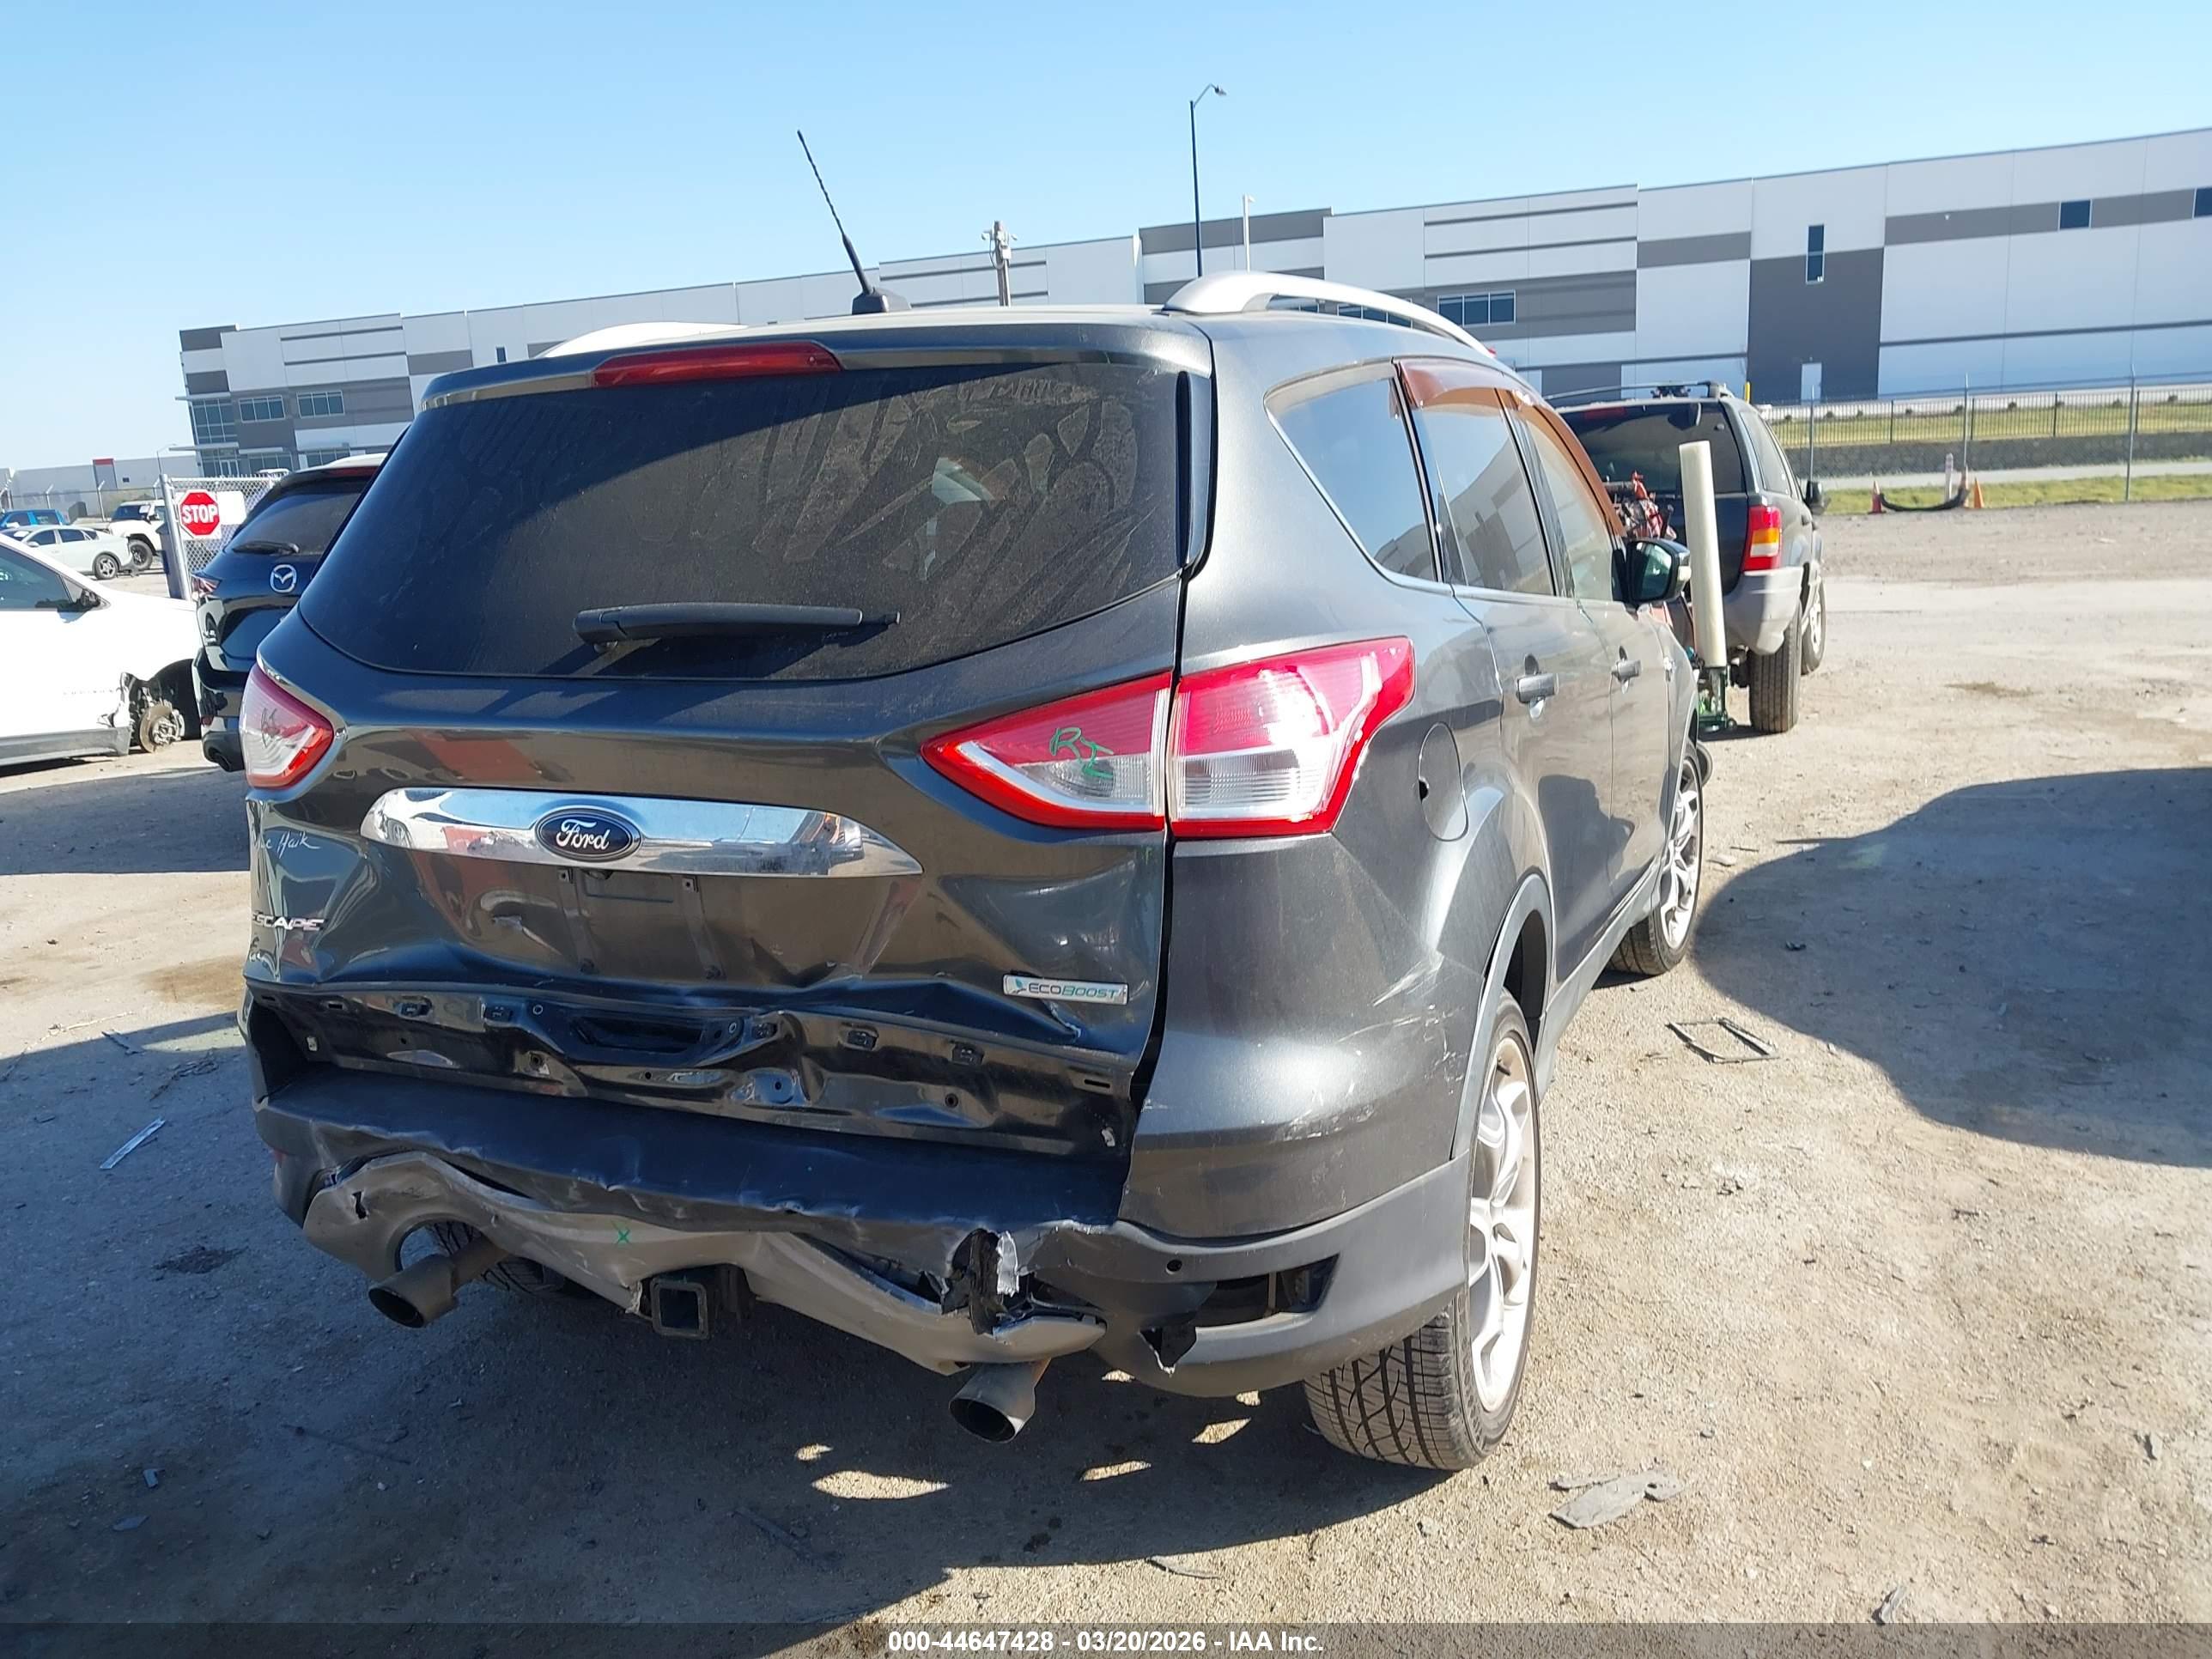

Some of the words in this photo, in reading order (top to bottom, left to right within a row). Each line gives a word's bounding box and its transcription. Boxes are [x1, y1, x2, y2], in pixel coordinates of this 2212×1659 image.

[182, 504, 218, 524] STOP
[276, 830, 321, 859] Haik
[556, 818, 611, 851] Ford
[252, 911, 325, 932] ESCAPE
[1029, 982, 1119, 999] ECOBOOST
